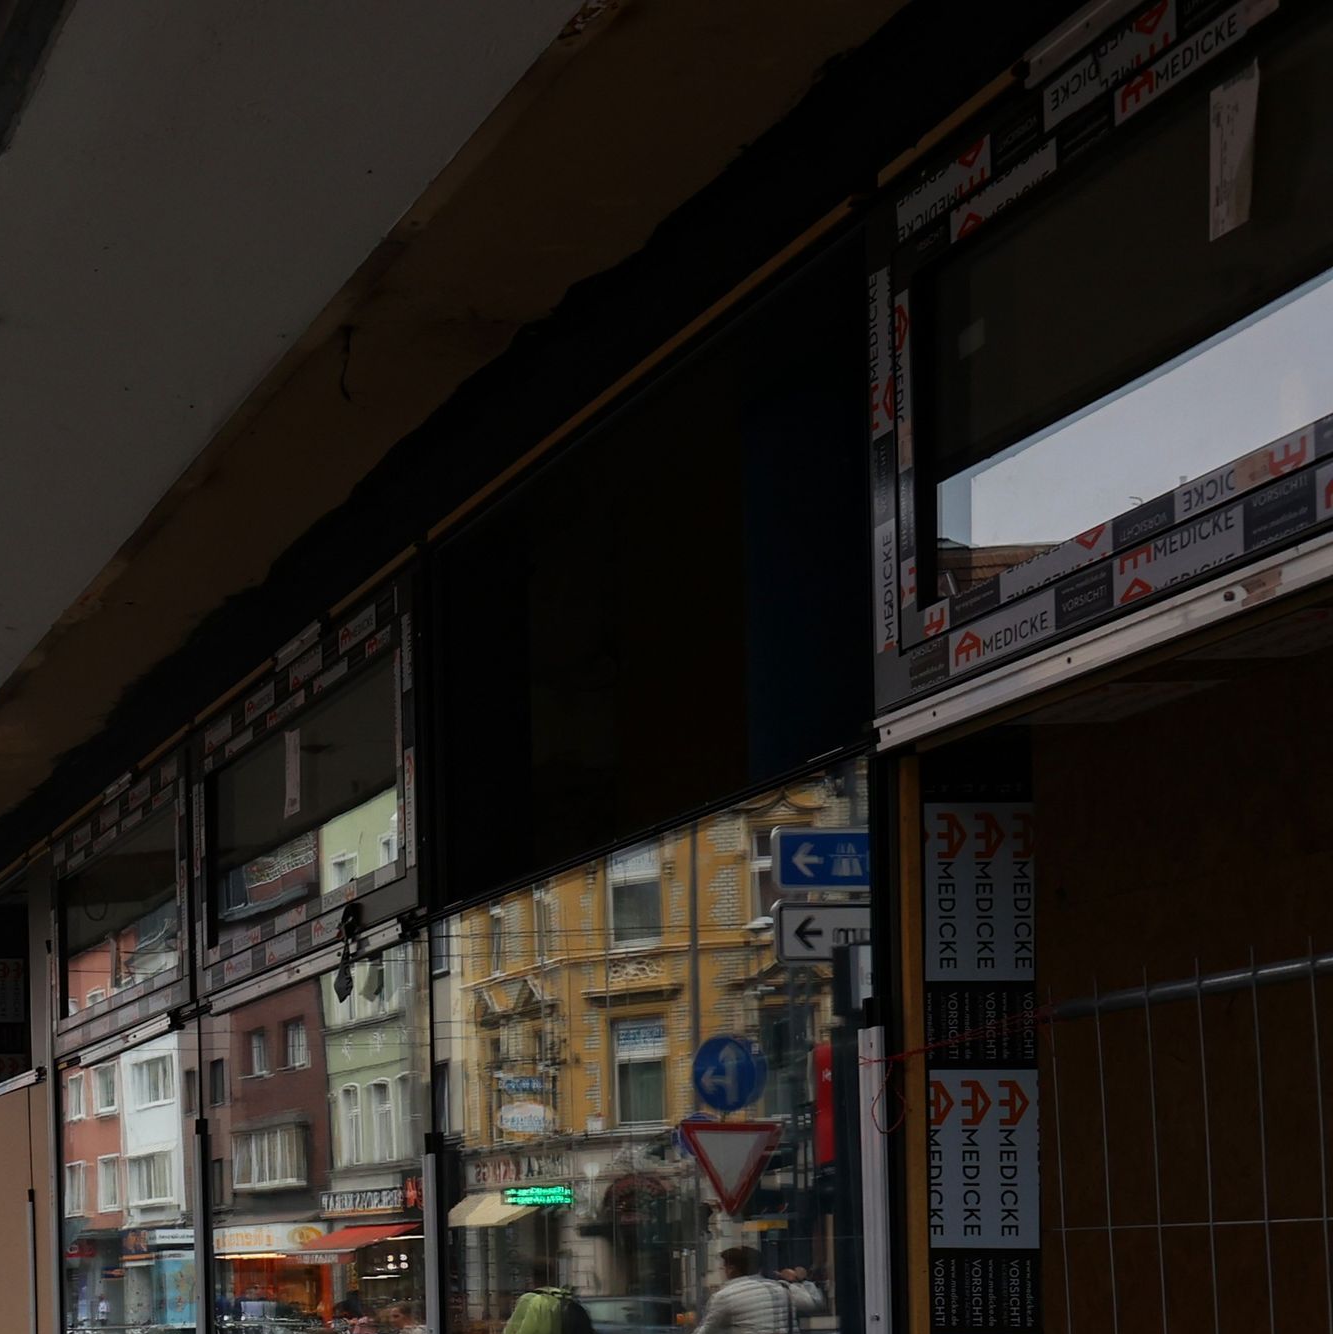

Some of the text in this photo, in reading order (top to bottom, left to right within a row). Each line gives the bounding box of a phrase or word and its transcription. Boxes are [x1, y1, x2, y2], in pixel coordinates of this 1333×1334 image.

[1154, 13, 1238, 89] MEDICKE
[1153, 509, 1235, 562] MEDICKE
[883, 531, 894, 643] MEDICKE
[1061, 584, 1108, 614] VORSICHT!
[982, 609, 1049, 658] MEDICKE
[937, 861, 957, 969] MEDICKE
[975, 861, 995, 969] MEDICKE
[1013, 861, 1033, 969] MEDICKE
[948, 992, 958, 1060] VORSICHT!
[985, 992, 997, 1060] VORSICHT!
[961, 1128, 981, 1237] MEDICKE
[999, 1128, 1019, 1237] MEDICKE
[934, 1259, 945, 1328] VORSICHT!
[971, 1259, 983, 1328] VORSICHT!
[1009, 1259, 1021, 1328] VORSICHT!
